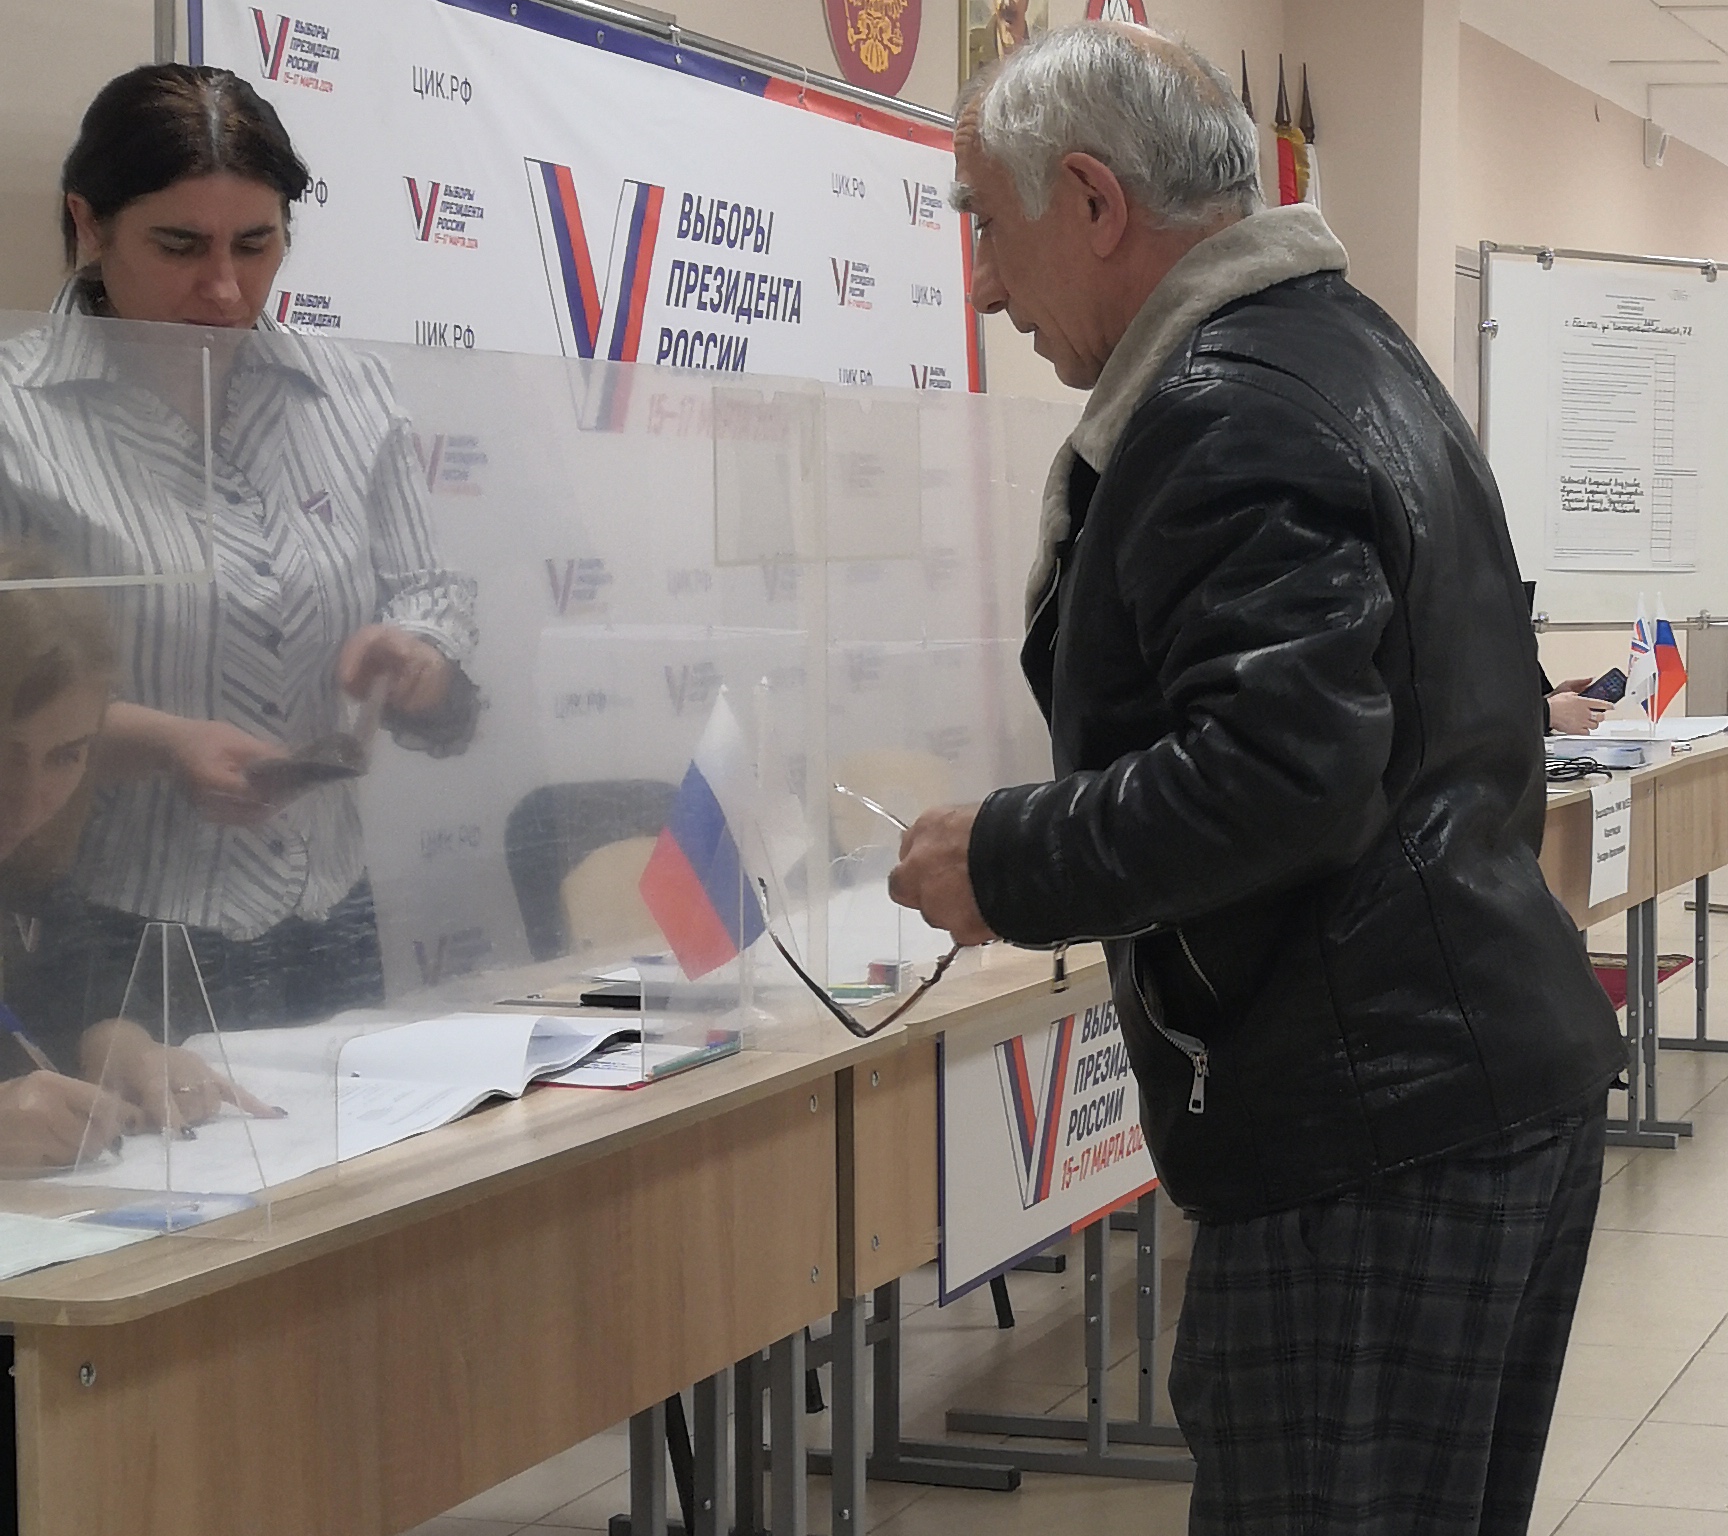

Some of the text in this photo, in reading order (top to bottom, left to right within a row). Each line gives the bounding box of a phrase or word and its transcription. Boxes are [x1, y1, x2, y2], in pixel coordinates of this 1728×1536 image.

[289, 37, 340, 61] ПРЕЗИДЕНТА
[294, 20, 330, 40] ВЫБОРЫ
[285, 54, 319, 74] РОССИИ
[412, 64, 473, 105] ЦИК.РФ
[676, 192, 774, 255] ВЫБОРЫ
[665, 259, 802, 325] ПРЕЗИДЕНТА
[655, 326, 749, 373] РОССИИ
[1065, 1085, 1126, 1147] РОССИИ
[1091, 1130, 1126, 1176] МАРТА
